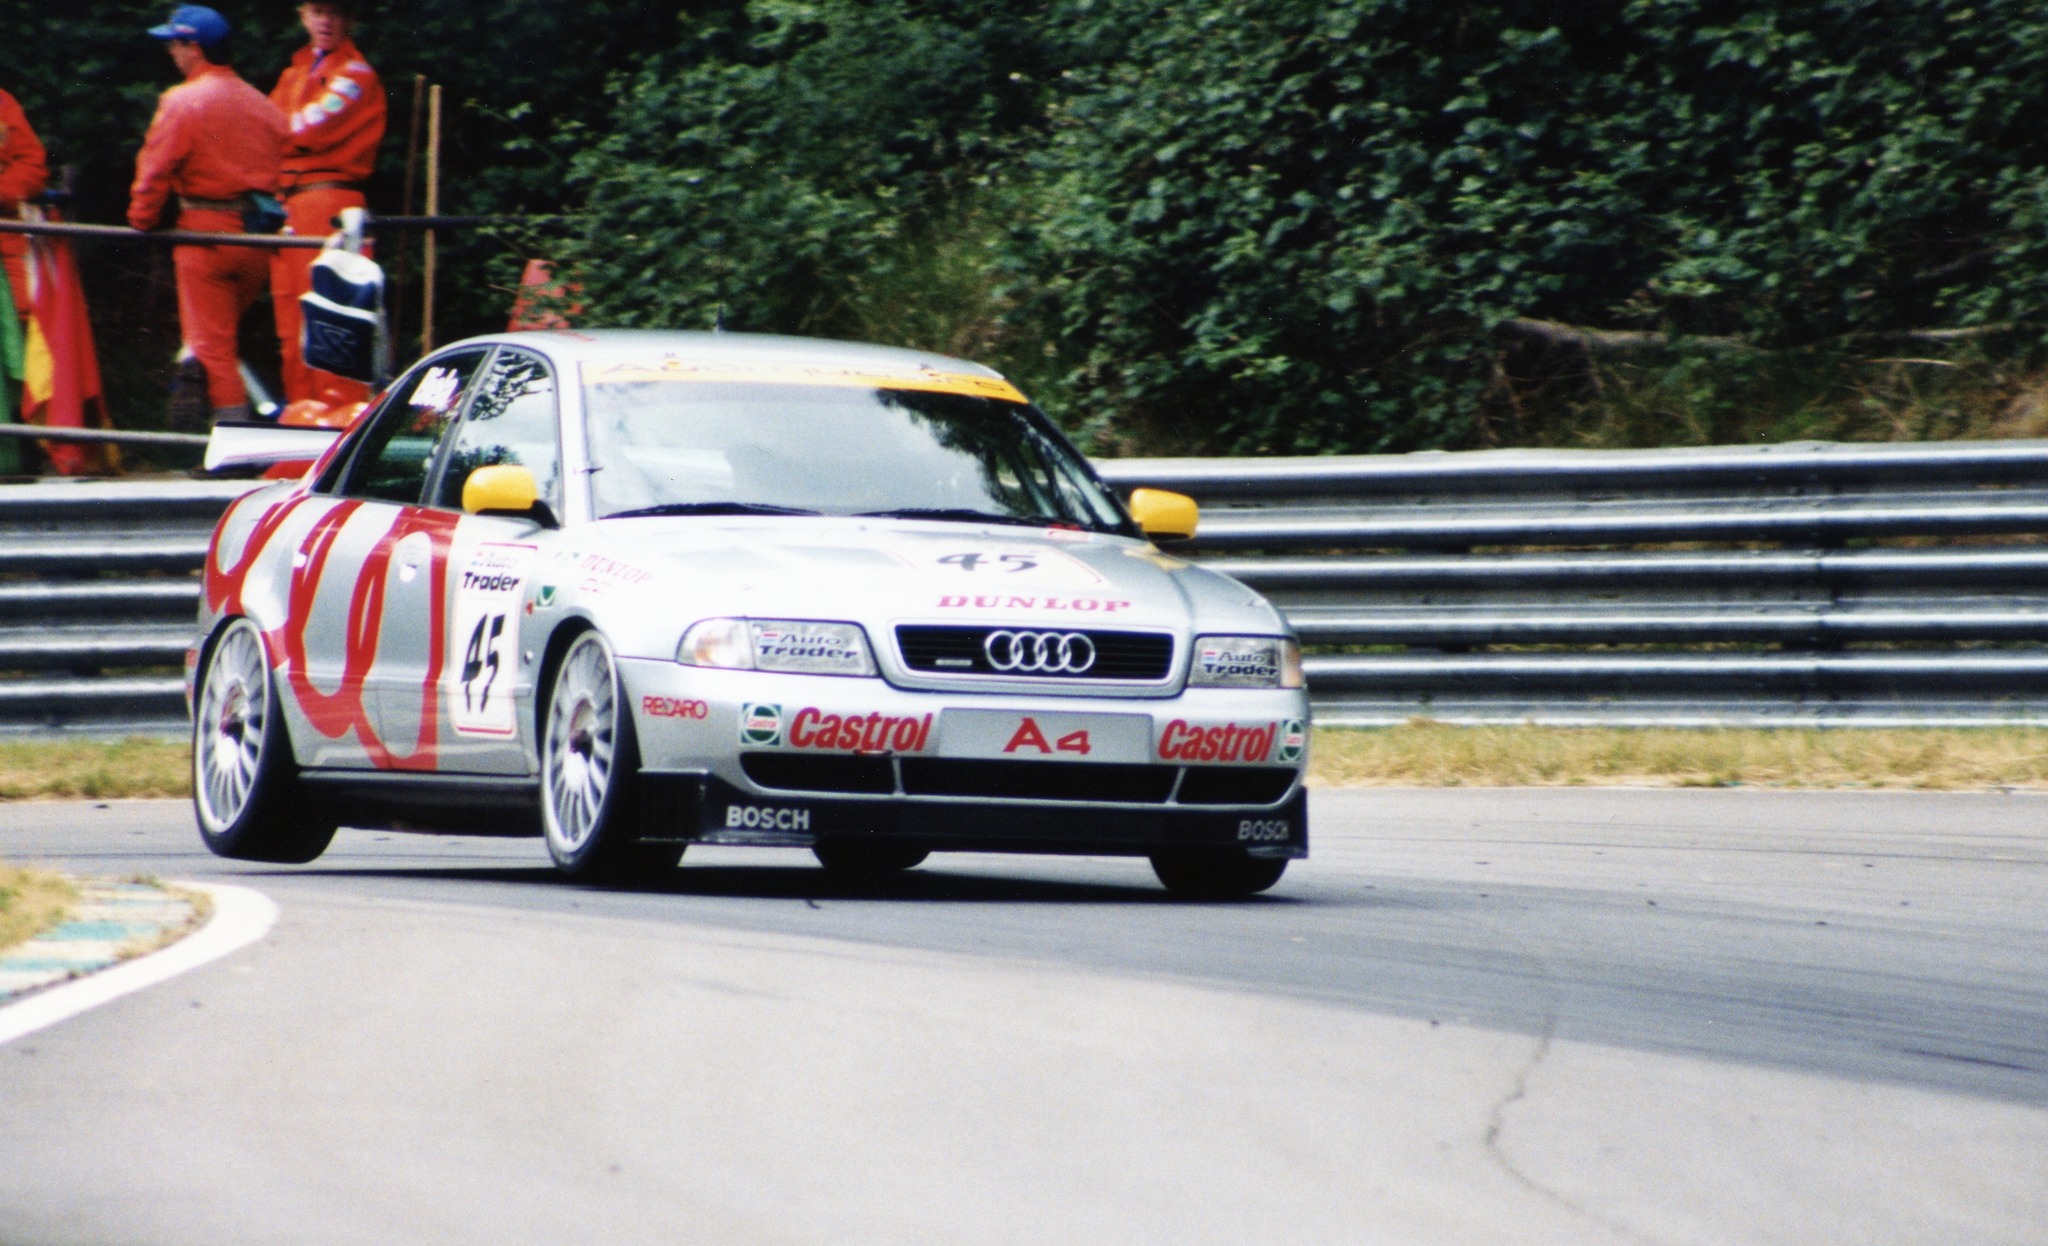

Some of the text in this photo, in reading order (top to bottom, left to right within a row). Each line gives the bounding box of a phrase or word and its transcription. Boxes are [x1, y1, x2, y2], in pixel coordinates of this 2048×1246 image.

[936, 552, 1038, 573] 45
[463, 572, 520, 591] Trader
[936, 595, 1131, 612] DUNLOP
[780, 633, 843, 645] Auto
[759, 644, 858, 659] Trader
[1218, 651, 1268, 663] Auto
[461, 613, 505, 713] 45
[1203, 662, 1278, 676] Trader
[642, 695, 707, 719] RECARO
[789, 706, 933, 752] Castrol
[1003, 717, 1091, 755] A4
[1158, 719, 1278, 762] Castrol
[725, 805, 810, 829] BOSCH
